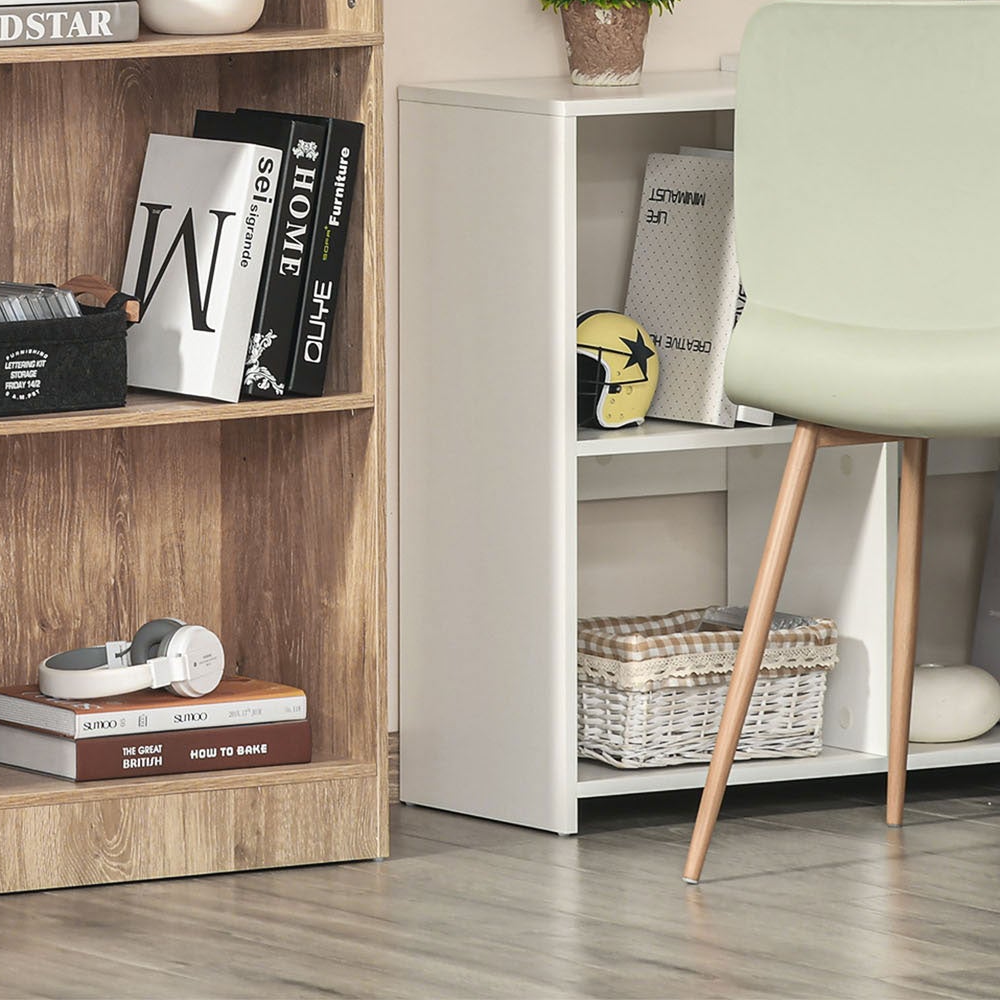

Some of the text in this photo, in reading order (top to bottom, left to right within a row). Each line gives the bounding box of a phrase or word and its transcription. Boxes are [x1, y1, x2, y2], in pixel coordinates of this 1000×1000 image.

[328, 146, 351, 227] Furniture
[648, 187, 707, 206] MINIMALIST
[240, 156, 274, 269] sei sigrande
[646, 209, 668, 225] LIFE
[279, 167, 316, 277] HOME
[127, 202, 236, 333] M
[665, 335, 712, 354] CREATIVE
[4, 359, 47, 370] LETTERING KIT
[10, 369, 38, 380] STORAGE
[4, 380, 27, 390] FRIDAY
[122, 744, 163, 756] THE GREAT
[190, 743, 268, 759] HOW TO BAKE
[122, 756, 163, 769] BRITISH
